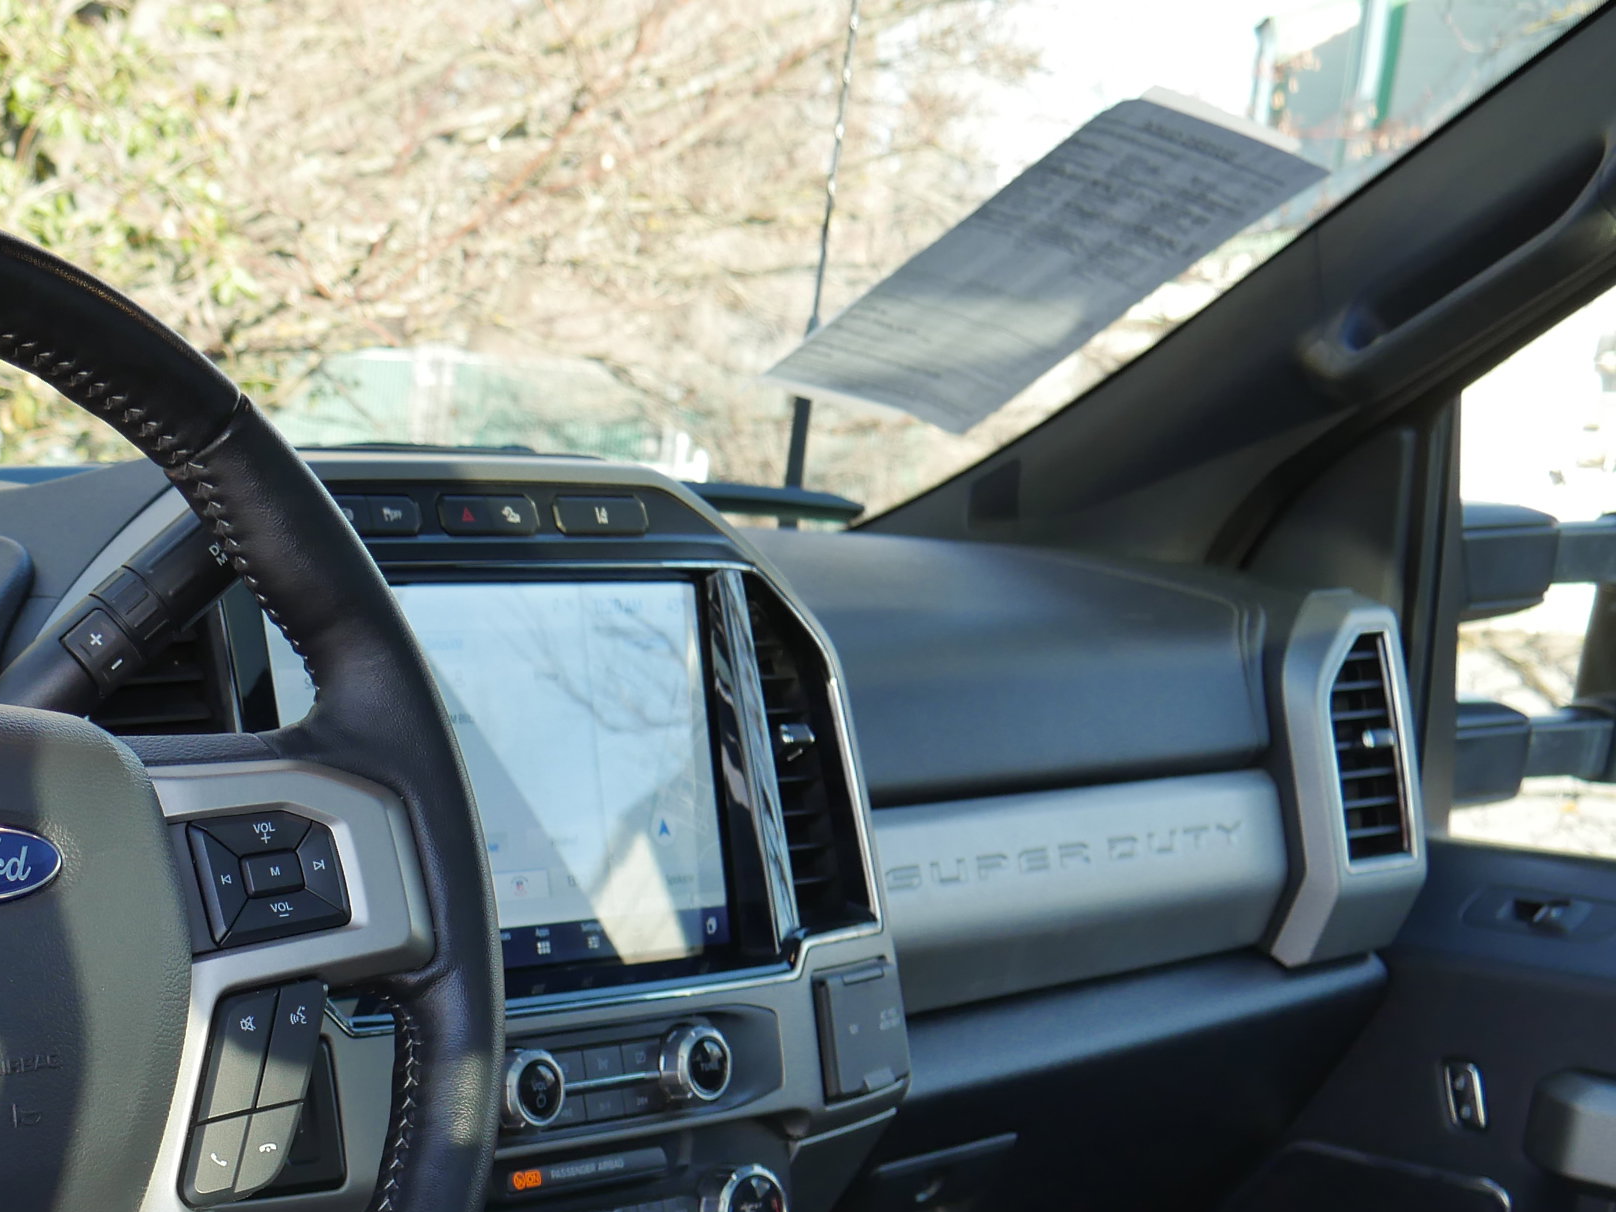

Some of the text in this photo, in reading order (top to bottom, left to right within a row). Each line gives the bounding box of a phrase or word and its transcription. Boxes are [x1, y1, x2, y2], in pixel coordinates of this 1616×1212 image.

[253, 822, 276, 834] VOL
[885, 820, 1243, 891] SUPER DUTY
[270, 866, 281, 877] M
[270, 902, 294, 913] VOL
